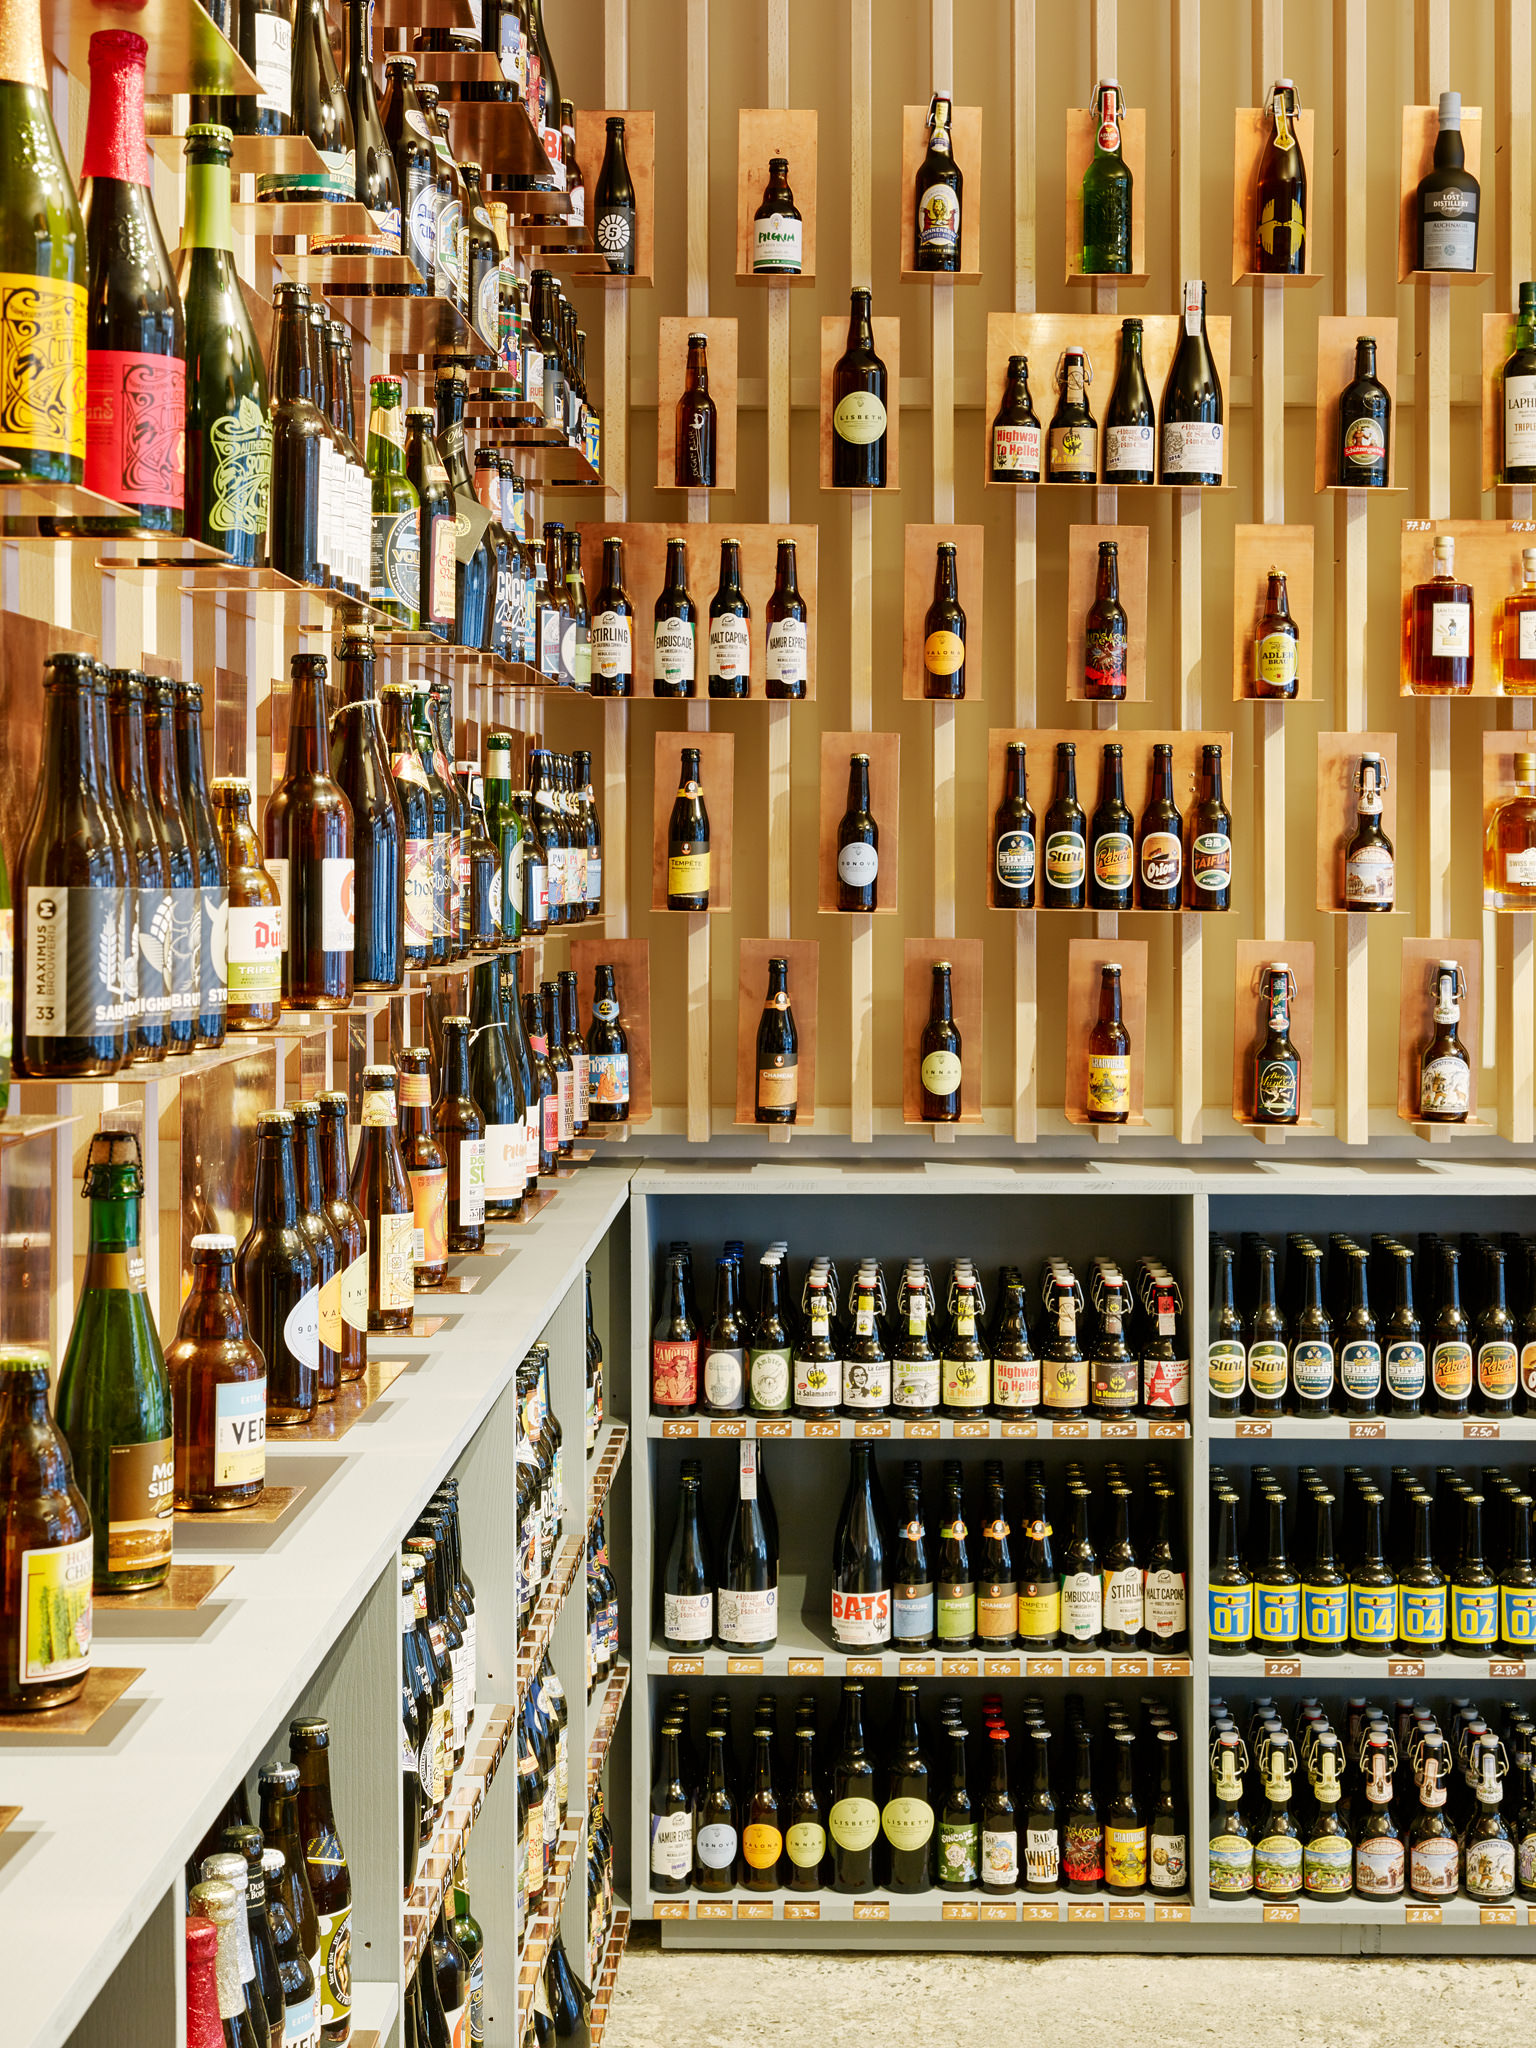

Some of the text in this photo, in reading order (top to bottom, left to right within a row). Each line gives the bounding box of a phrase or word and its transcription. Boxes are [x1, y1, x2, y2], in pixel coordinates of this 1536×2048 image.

[609, 226, 618, 238] 5
[758, 231, 796, 243] PILGRIM
[997, 429, 1038, 443] Highway
[1065, 433, 1081, 444] BFM
[997, 443, 1039, 458] To Helles
[591, 628, 628, 644] STIRLING
[656, 635, 692, 650] EMBUSCADE
[710, 631, 748, 646] MALT CAPONE
[1262, 652, 1294, 660] ADLER
[1048, 850, 1083, 862] Start
[1195, 852, 1230, 870] TAIFUN
[1146, 861, 1175, 880] Orion
[36, 924, 47, 995] MAXIMUS
[46, 924, 56, 996] BROUWERIJ
[36, 1006, 55, 1020] 33
[809, 1368, 825, 1377] BFM
[959, 1368, 975, 1377] BFM
[997, 1365, 1039, 1377] Highway
[1209, 1360, 1242, 1371] Start
[1252, 1360, 1285, 1372] Start
[998, 1379, 1040, 1392] To Helles
[1064, 1590, 1101, 1603] EMBUSCADE
[1146, 1587, 1185, 1601] MALT CAPONE
[832, 1593, 888, 1621] BATS
[1214, 1607, 1245, 1633] 01
[1264, 1607, 1294, 1633] 01
[1311, 1608, 1341, 1634] 01
[1358, 1608, 1393, 1634] 04
[1407, 1608, 1442, 1634] 04
[834, 1818, 876, 1826] LISBETH
[887, 1818, 929, 1826] LISBETH
[658, 1832, 678, 1843] NAMUR
[1026, 1847, 1058, 1866] WHITE
